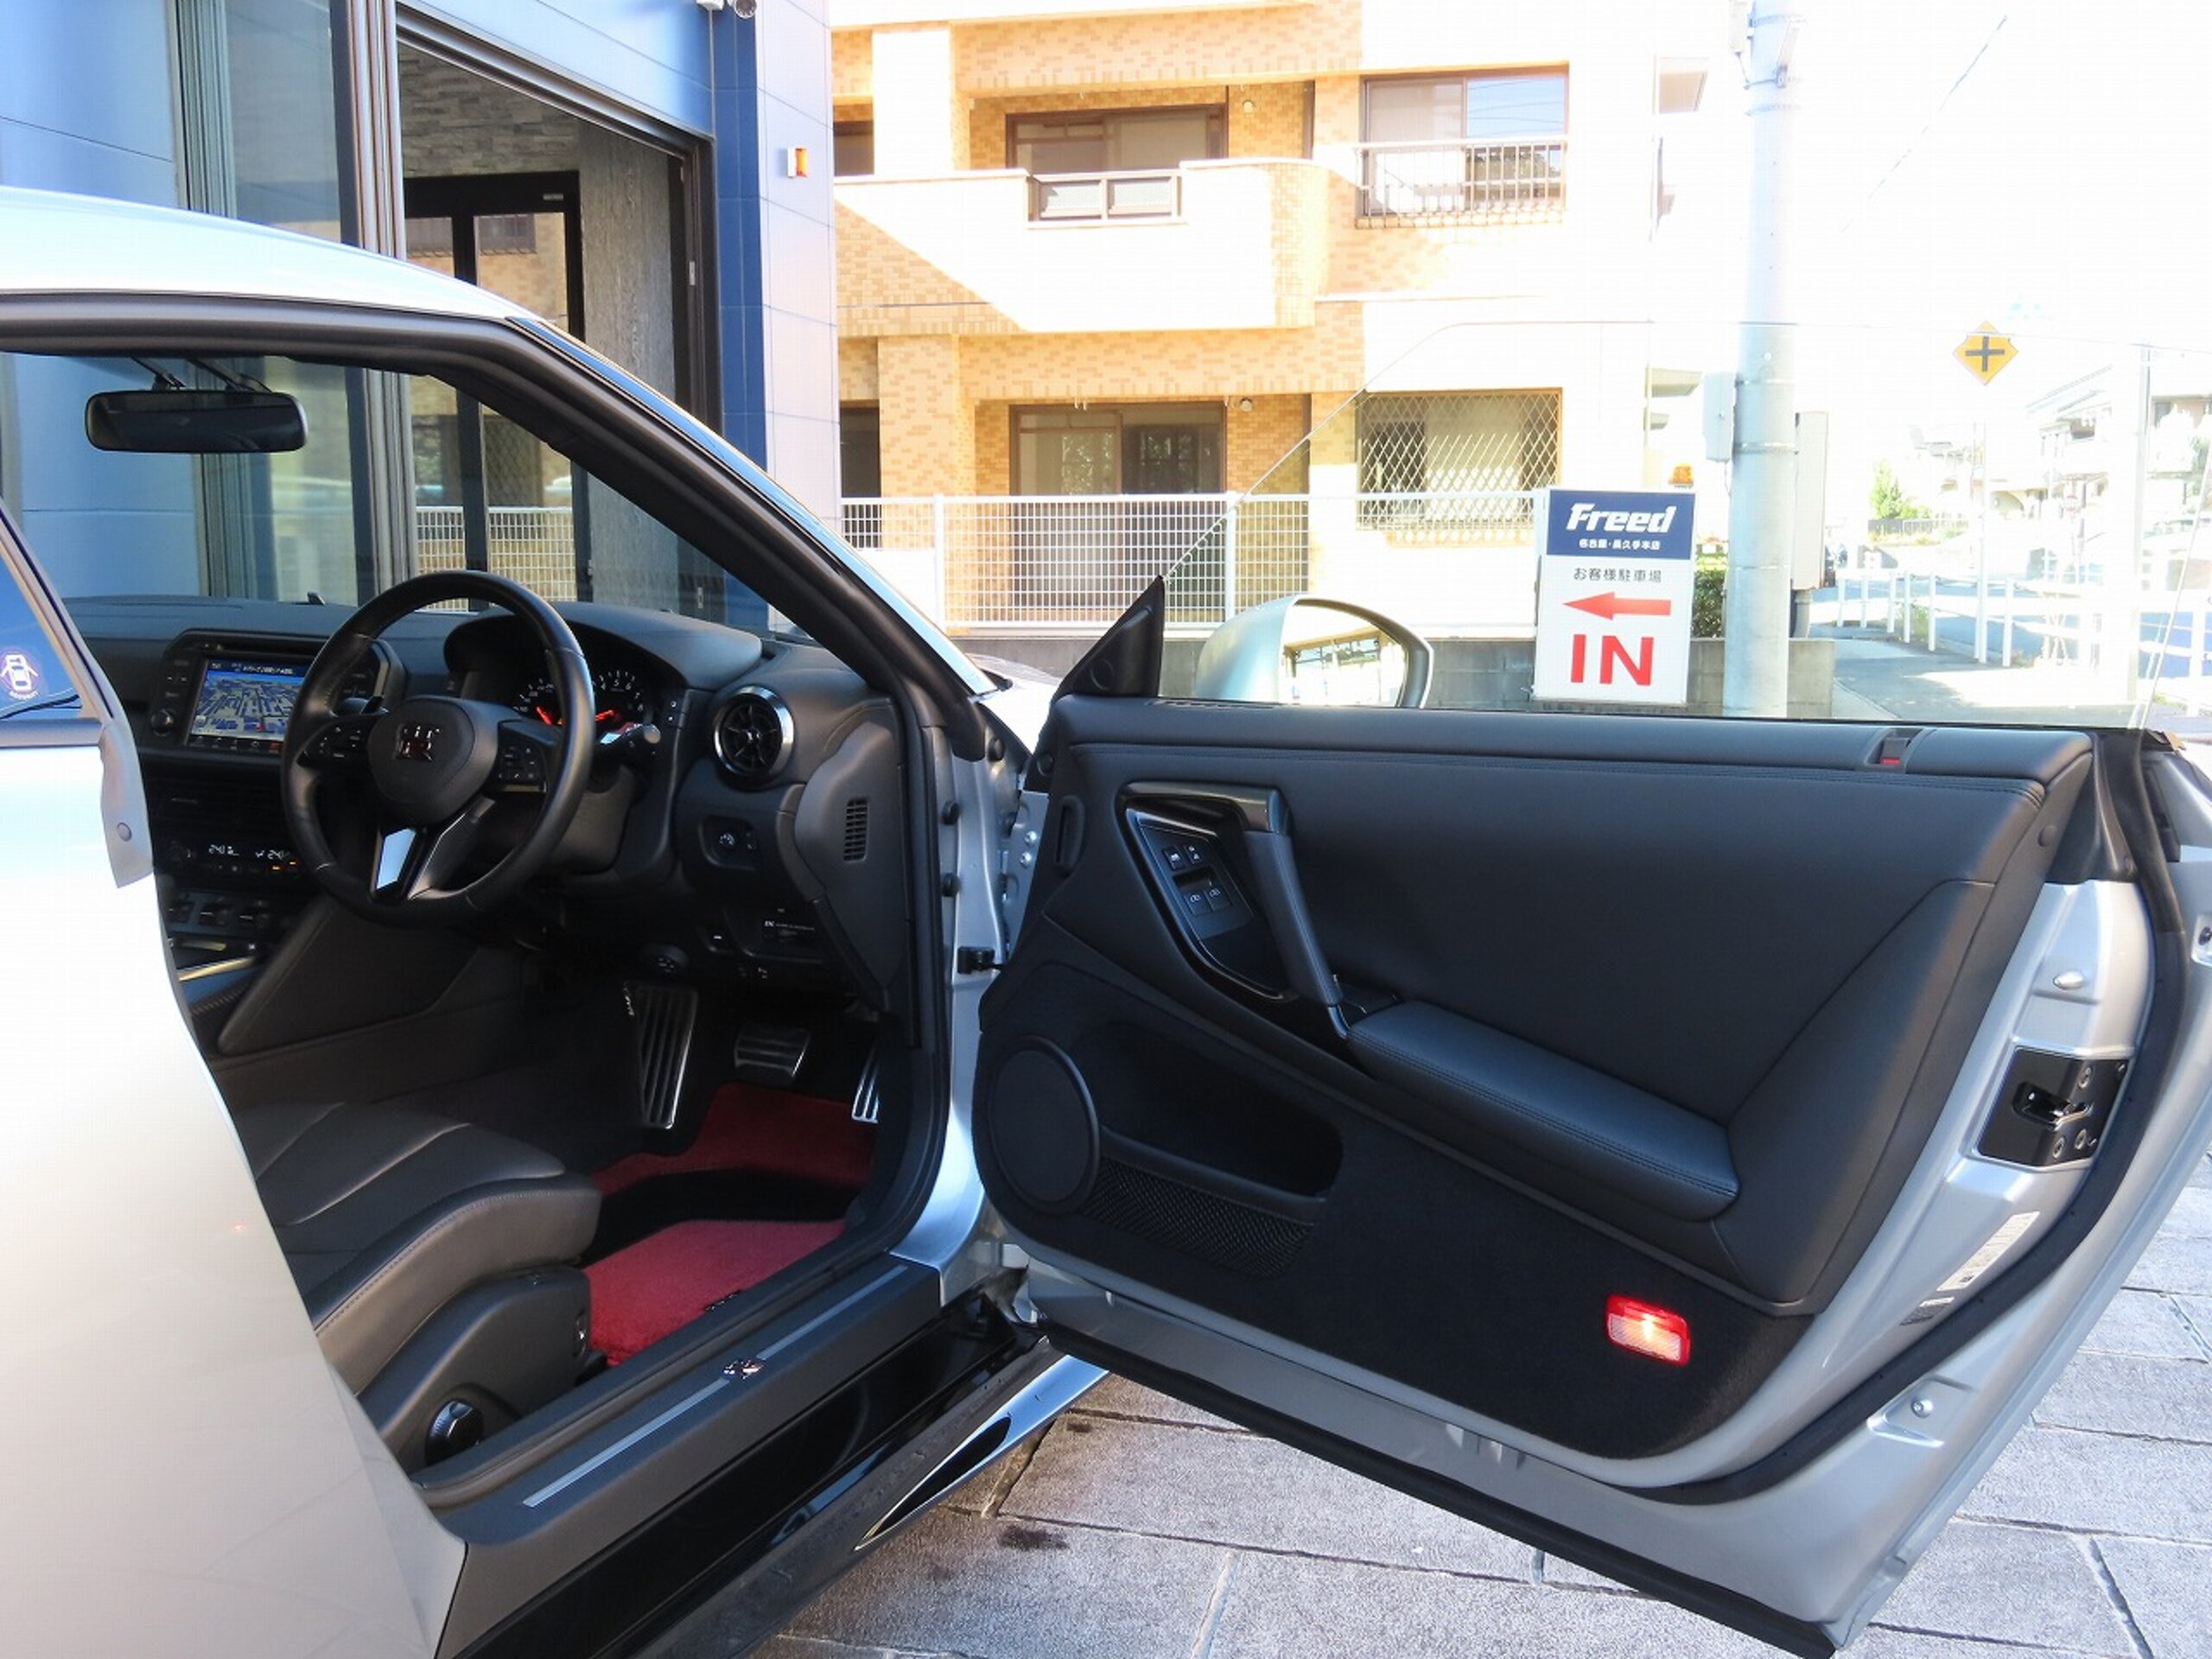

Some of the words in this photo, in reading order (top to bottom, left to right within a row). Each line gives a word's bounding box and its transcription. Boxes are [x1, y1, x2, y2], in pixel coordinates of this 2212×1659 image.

[1566, 503, 1677, 533] Freed
[1573, 568, 1662, 583] お客様駐車場
[1571, 634, 1654, 686] IN
